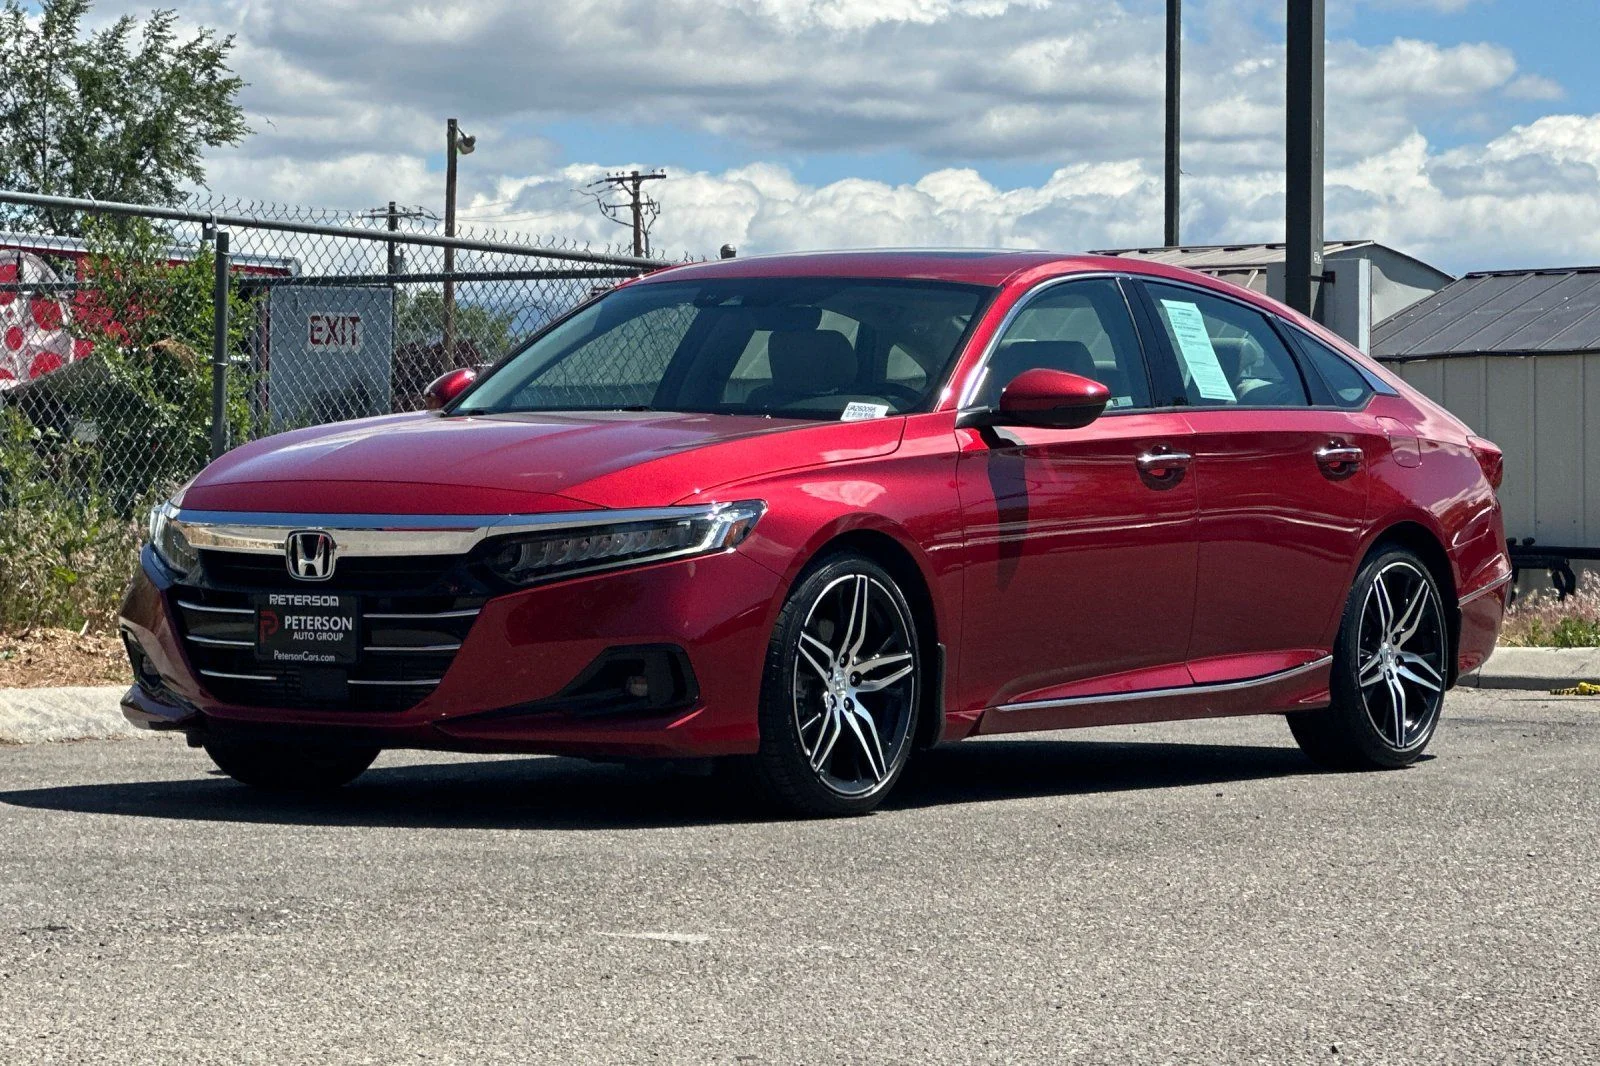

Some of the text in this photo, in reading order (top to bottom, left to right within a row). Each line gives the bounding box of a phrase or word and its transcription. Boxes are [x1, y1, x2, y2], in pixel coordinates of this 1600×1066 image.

[310, 316, 361, 346] EXIT
[284, 616, 353, 631] PETERSON
[293, 632, 344, 641] AUTO GROUP
[274, 650, 335, 662] PetersonCars.com
